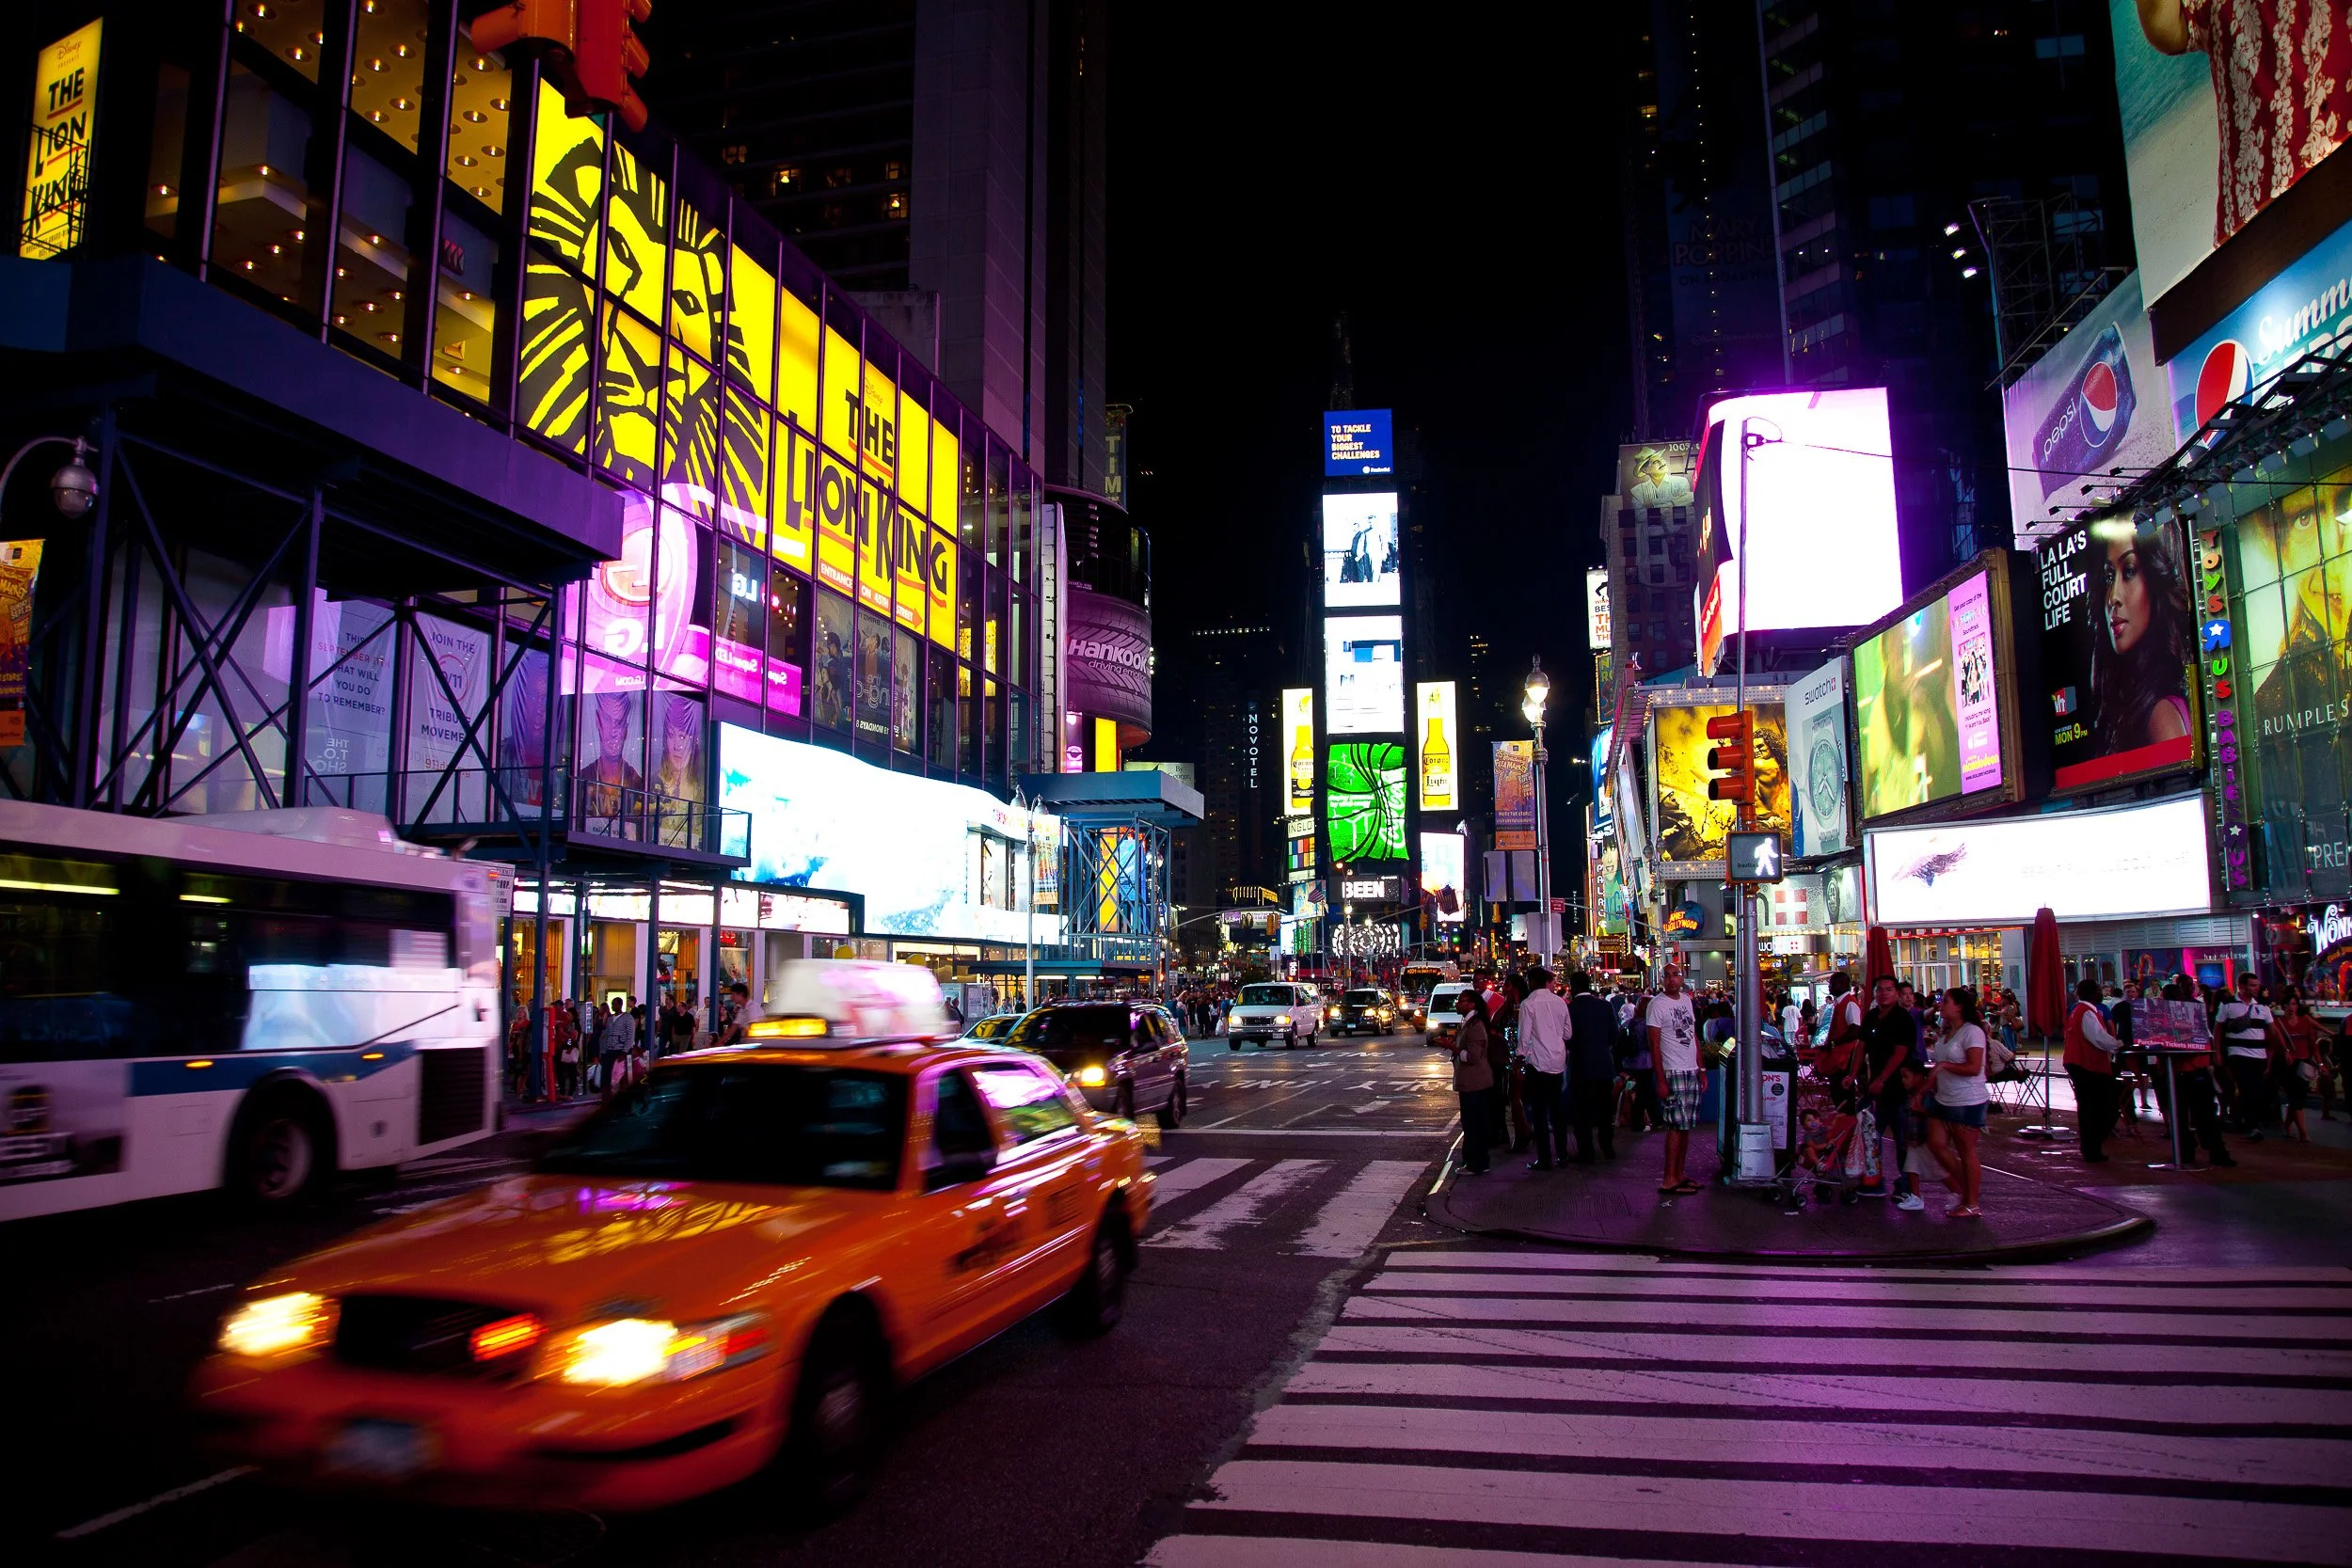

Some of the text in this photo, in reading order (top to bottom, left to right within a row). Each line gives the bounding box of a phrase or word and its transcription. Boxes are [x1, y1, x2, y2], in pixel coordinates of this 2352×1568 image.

[48, 67, 85, 112] THE
[34, 110, 87, 178] LION
[845, 388, 894, 467] THE
[1331, 424, 1371, 434] TO TACKLE
[1331, 434, 1352, 442] YOUR
[2042, 398, 2077, 461] pepsi
[1331, 442, 1363, 451] BIGGEST
[1331, 451, 1380, 460] CHALLENGES
[786, 408, 869, 546] LION
[876, 476, 947, 595] KING
[2041, 531, 2087, 570] LA LA'S
[2042, 562, 2073, 590] FULL
[820, 562, 914, 622] ENTRANCE ON 45TH STREET
[2043, 573, 2087, 610] COURT
[2044, 603, 2071, 631] LIFE
[2200, 530, 2224, 613] TOYS
[2212, 657, 2233, 698] US
[318, 641, 370, 662] SEPTEBER
[345, 633, 365, 644] THIS
[432, 632, 474, 654] JOIN THE
[358, 670, 379, 682] WILL
[1088, 659, 1122, 674] driving
[337, 680, 371, 696] YOU DO
[1804, 678, 1832, 705] swatch
[318, 691, 386, 716] TO REMEMBER?
[430, 707, 471, 723] TRIBUE
[421, 724, 465, 743] MOVEME
[2055, 730, 2073, 745] MON
[1248, 714, 1259, 788] NOVOTEL
[2313, 842, 2348, 869] PRE
[497, 880, 511, 890] CORP.
[1343, 881, 1385, 898] BEEN
[1597, 865, 1606, 918] PALAC
